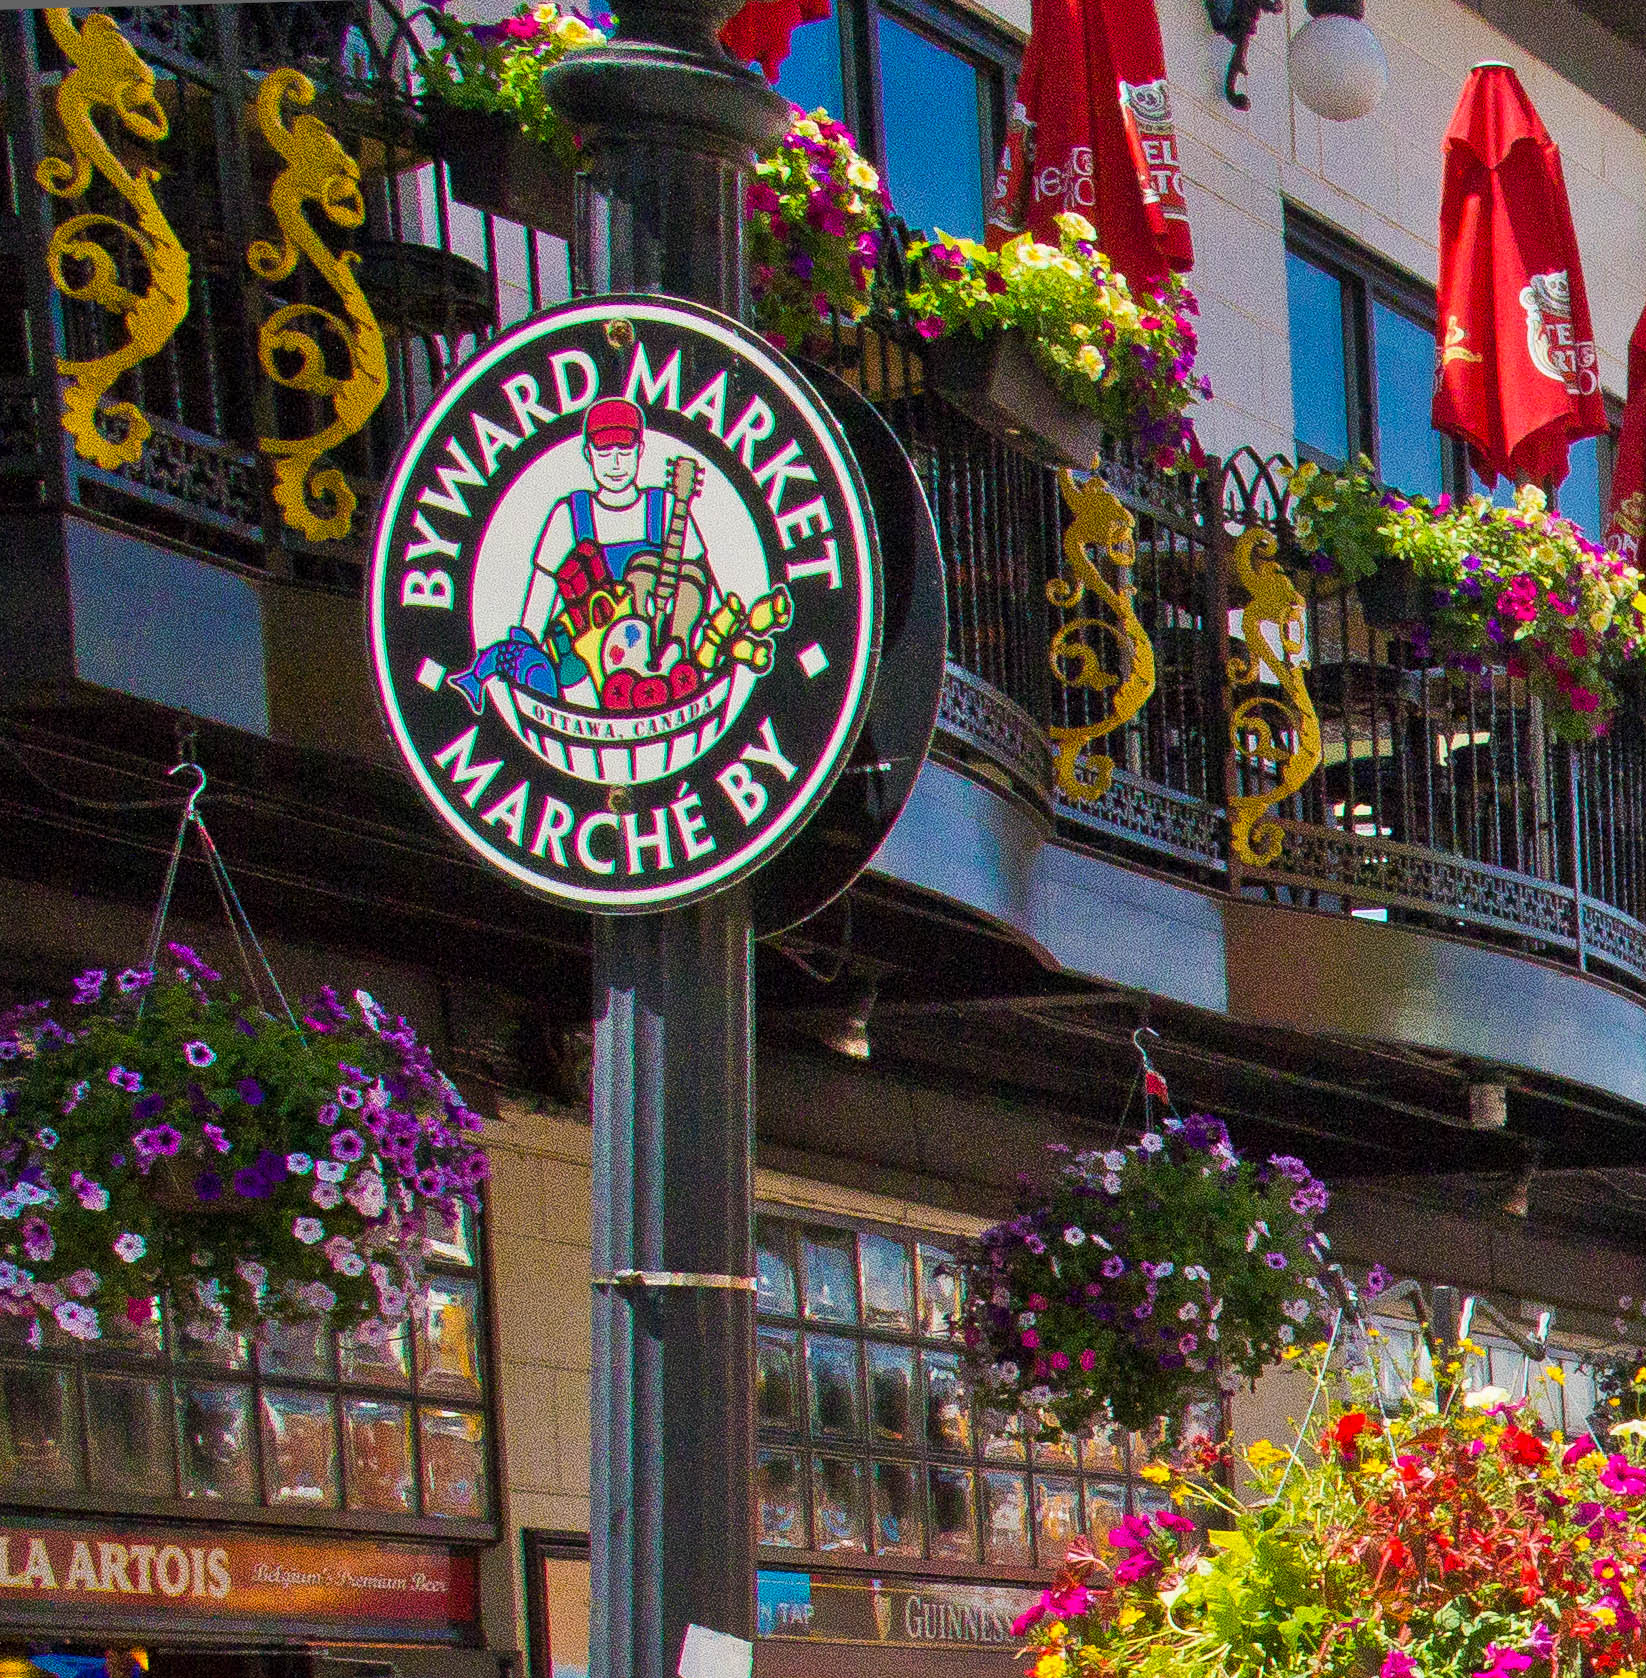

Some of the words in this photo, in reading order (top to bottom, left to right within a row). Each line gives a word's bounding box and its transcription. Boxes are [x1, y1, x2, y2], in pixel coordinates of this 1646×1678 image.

[402, 349, 600, 610] BYWARD
[621, 342, 841, 590] MARKET
[633, 697, 715, 739] CANADA
[434, 726, 717, 875] MARCHÉ
[716, 717, 800, 826] BY
[63, 1538, 233, 1600] ARTOIS
[253, 1560, 335, 1592] Belgium's
[411, 1571, 451, 1595] Beer
[778, 1603, 815, 1627] TAP
[904, 1594, 1018, 1643] GUINNESS
